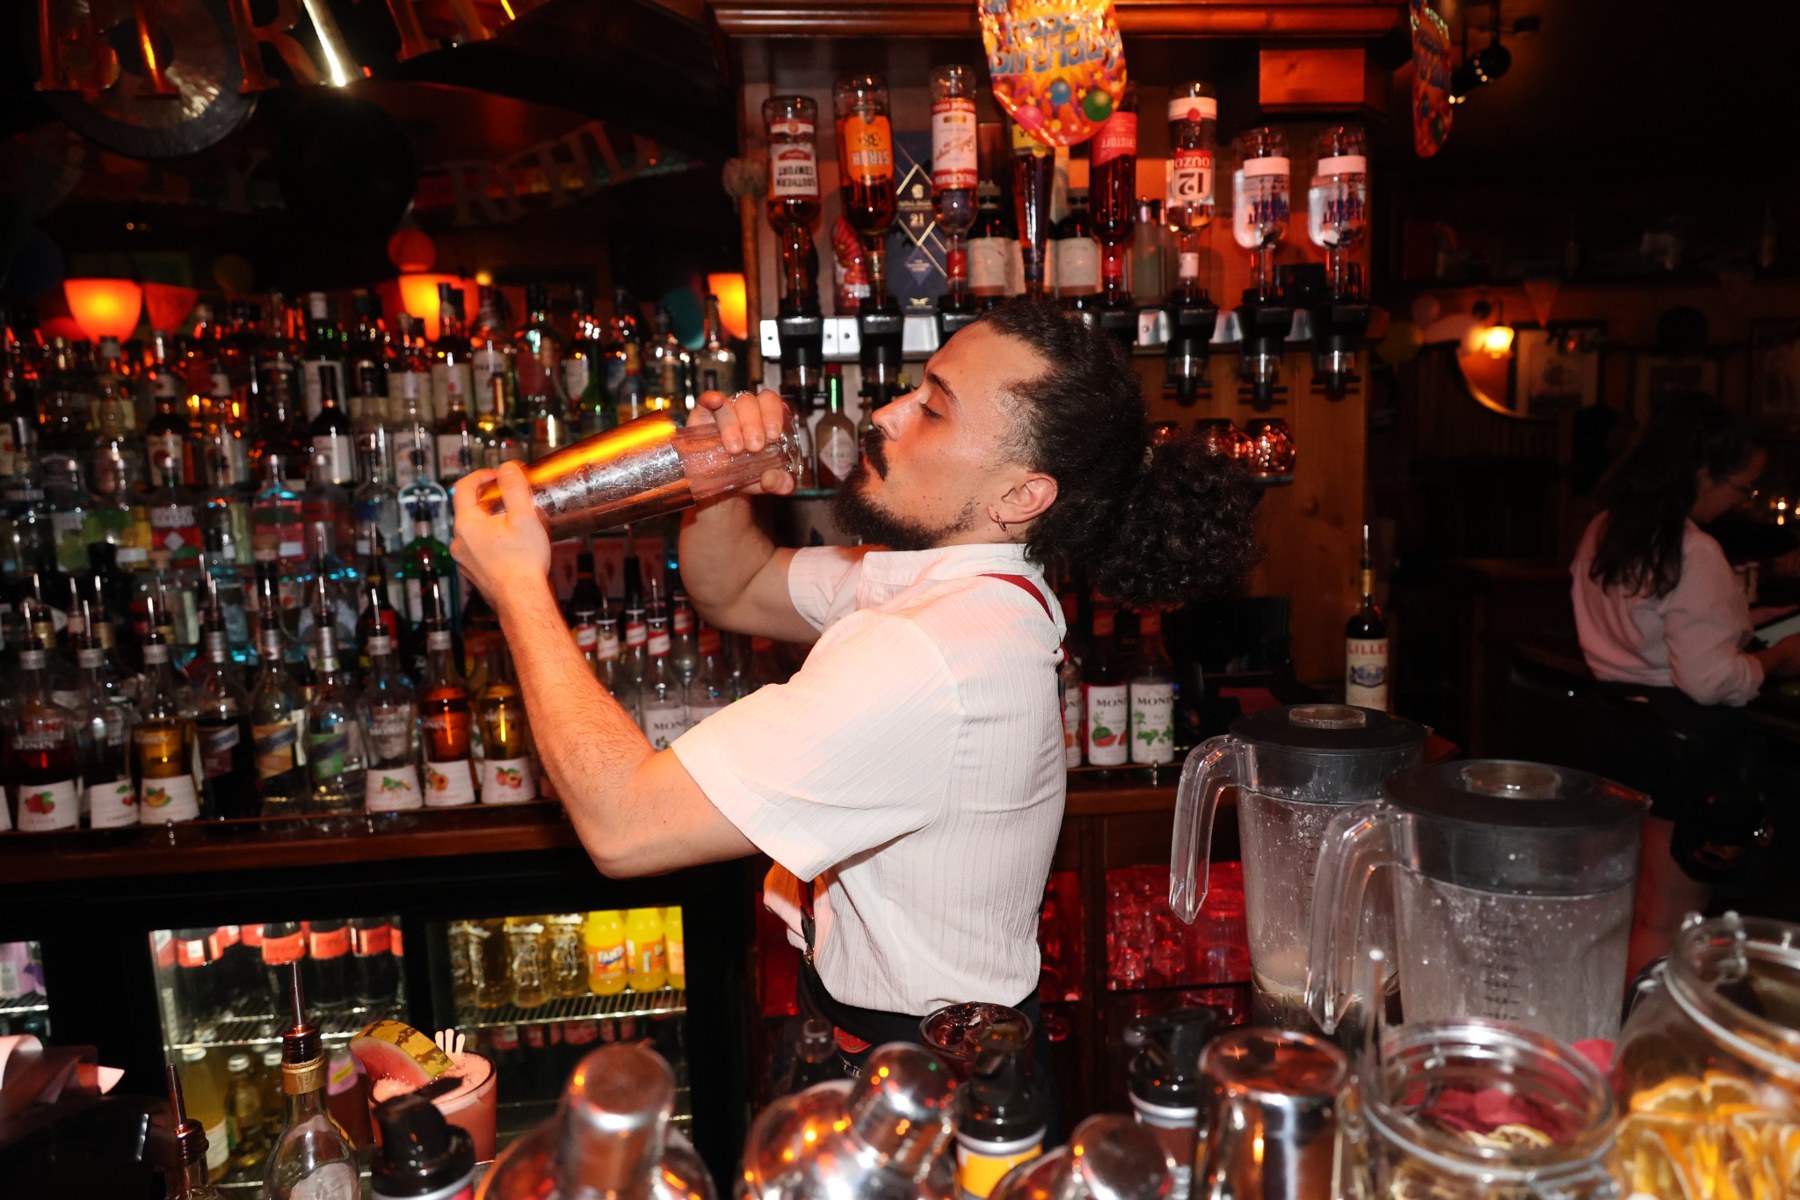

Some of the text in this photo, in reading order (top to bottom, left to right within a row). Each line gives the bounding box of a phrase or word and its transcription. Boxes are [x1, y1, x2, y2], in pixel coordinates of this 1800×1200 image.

[1175, 156, 1211, 168] OUZO
[778, 166, 814, 176] COMFORT
[776, 178, 817, 188] SOUTHERN
[1179, 172, 1204, 196] 12
[909, 212, 925, 228] 21
